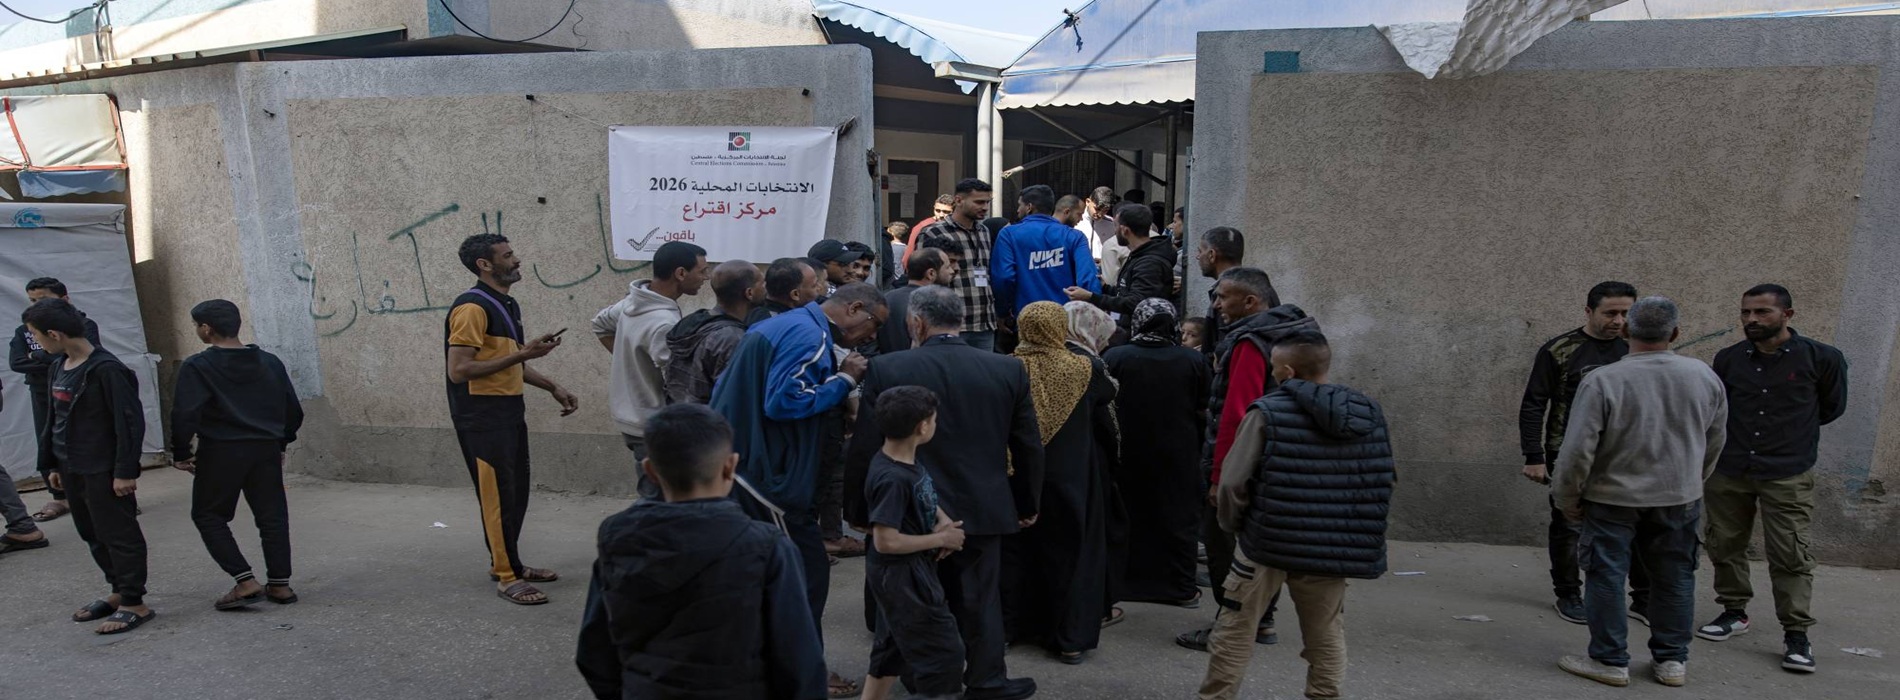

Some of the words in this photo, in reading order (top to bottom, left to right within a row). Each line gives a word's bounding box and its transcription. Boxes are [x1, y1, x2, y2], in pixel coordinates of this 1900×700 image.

[649, 177, 687, 191] 2026
[691, 180, 742, 195] المحلية
[746, 181, 815, 196] الانتخابات
[682, 201, 731, 222] اقتراع
[734, 201, 777, 219] مركز
[1028, 246, 1065, 270] NIKE
